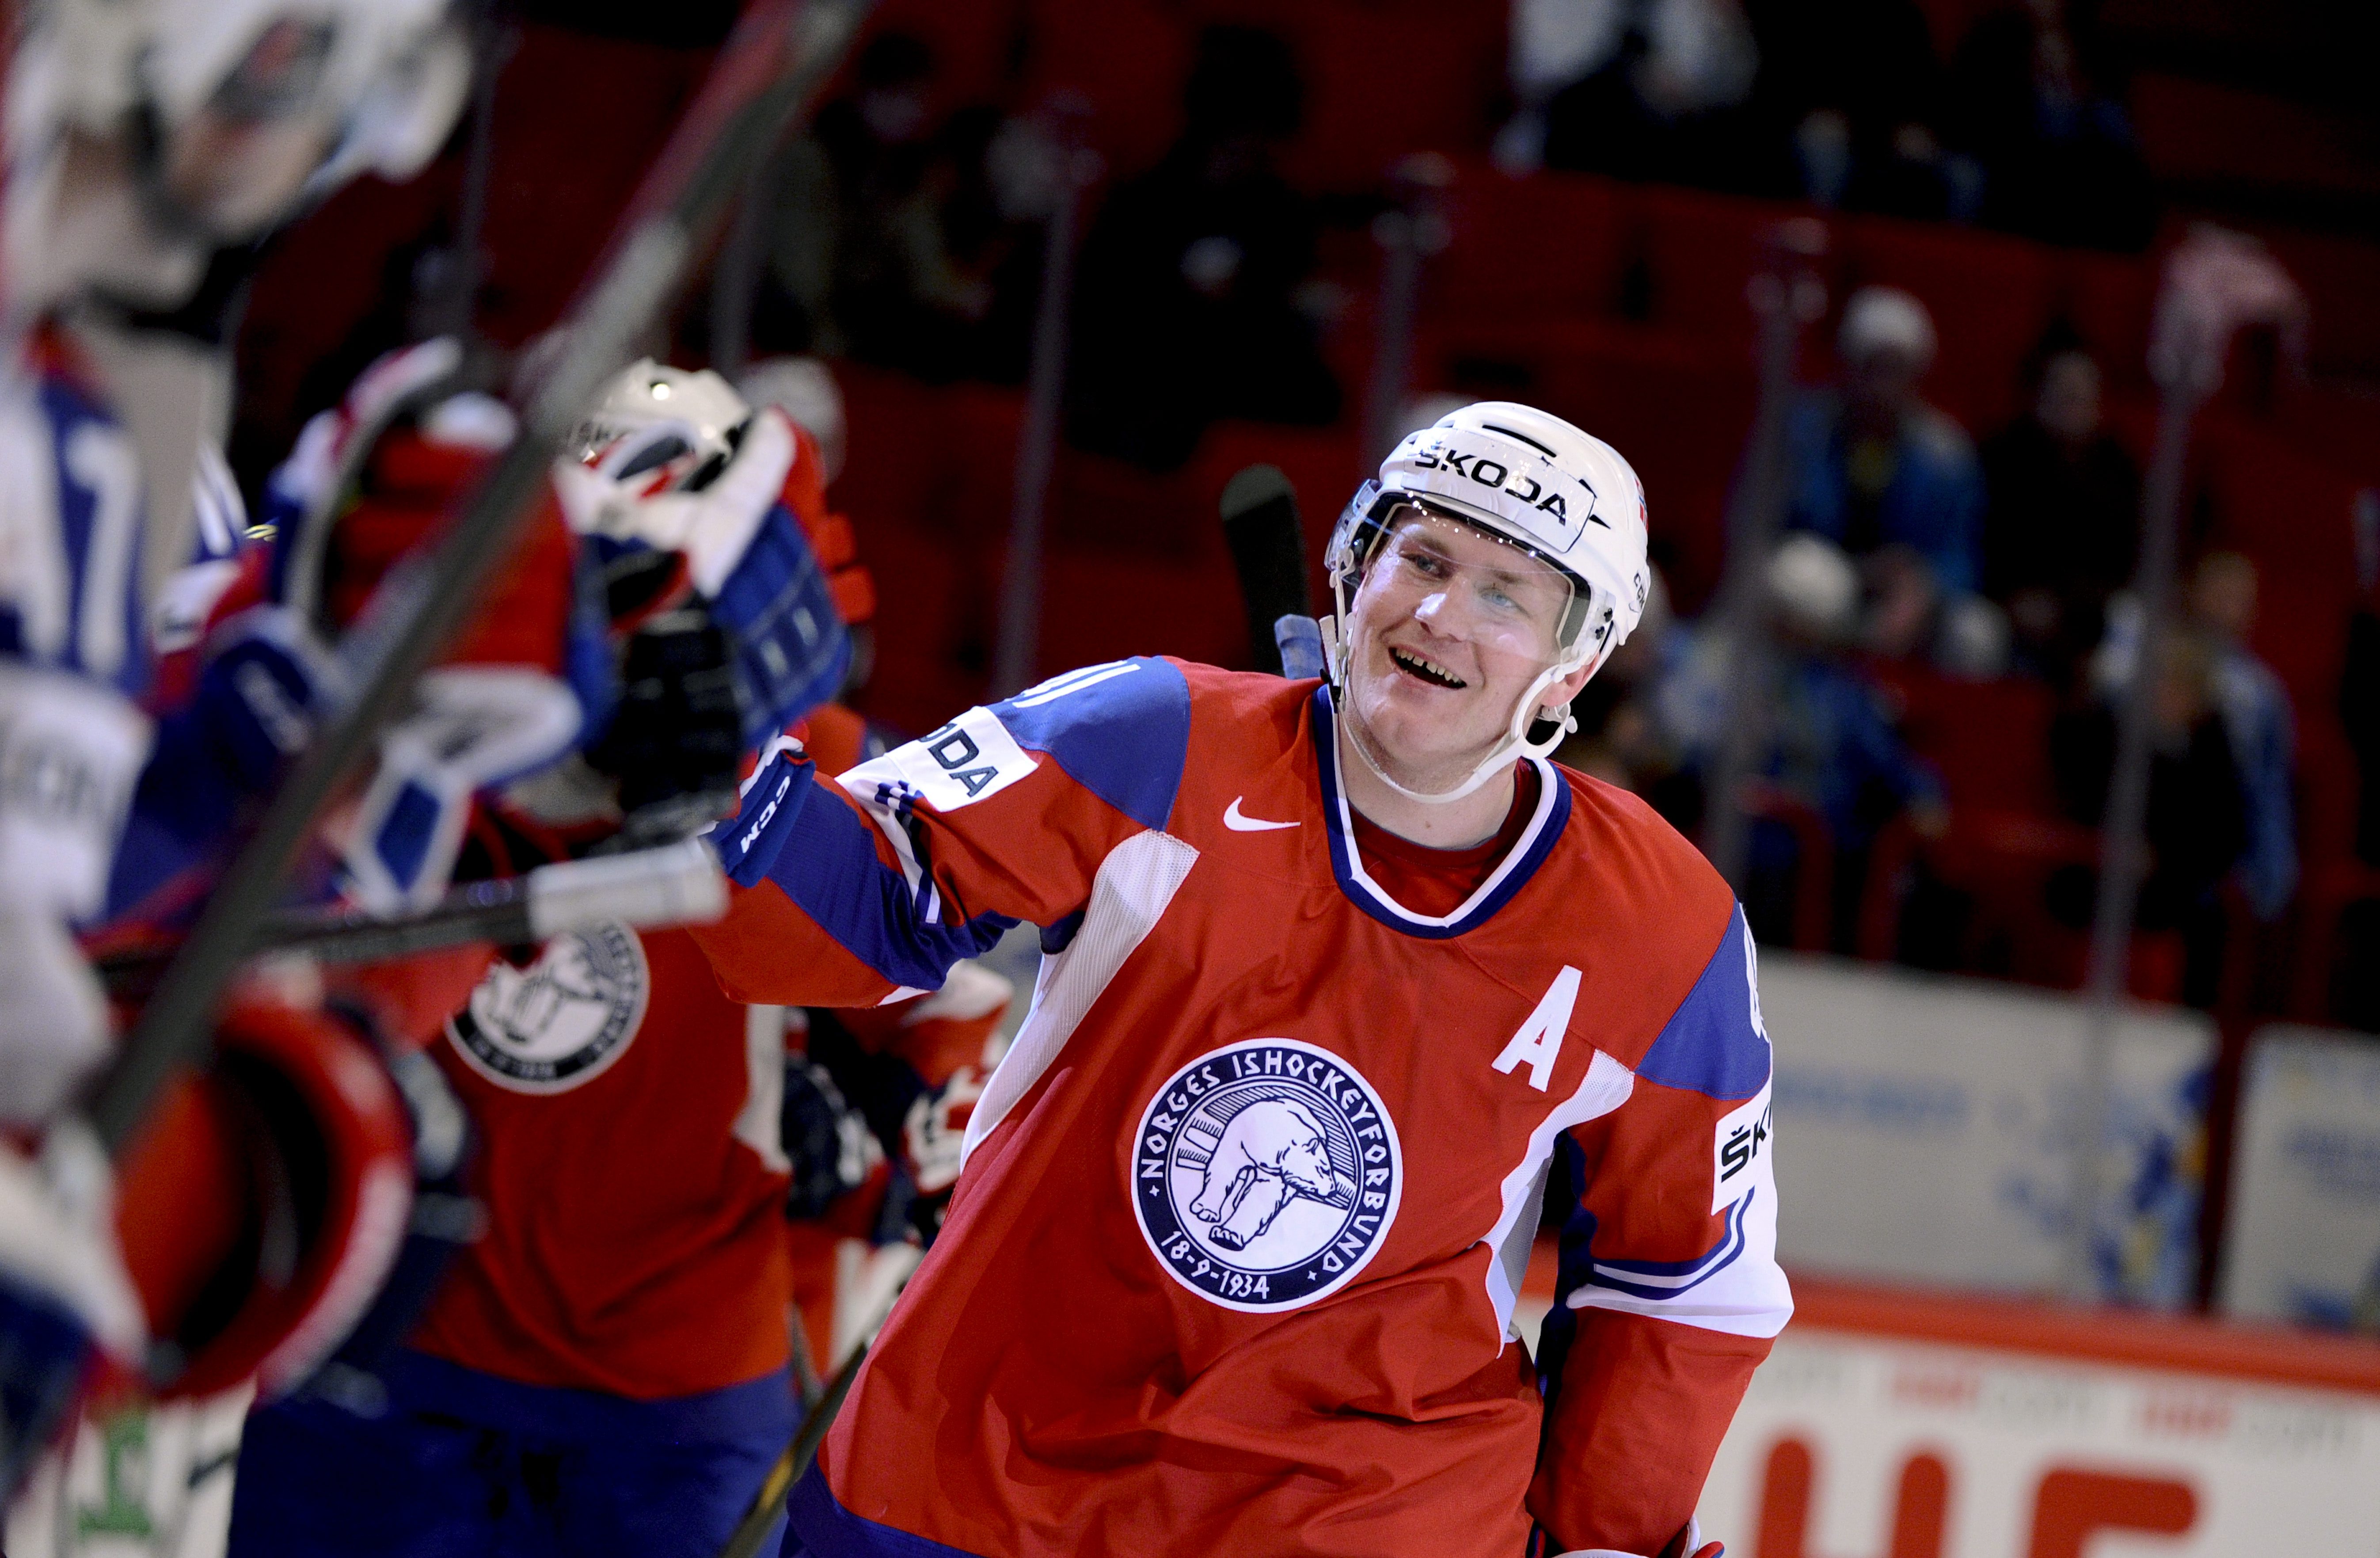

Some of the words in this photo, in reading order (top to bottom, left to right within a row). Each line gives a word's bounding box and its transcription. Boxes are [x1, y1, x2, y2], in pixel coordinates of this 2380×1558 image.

[740, 775, 791, 853] CCM
[1491, 964, 1583, 1093] A
[1141, 1065, 1220, 1178] NORGES
[1232, 1050, 1389, 1273] ISHOCKEYFORBUND
[1161, 1230, 1270, 1299] 18-9-1934
